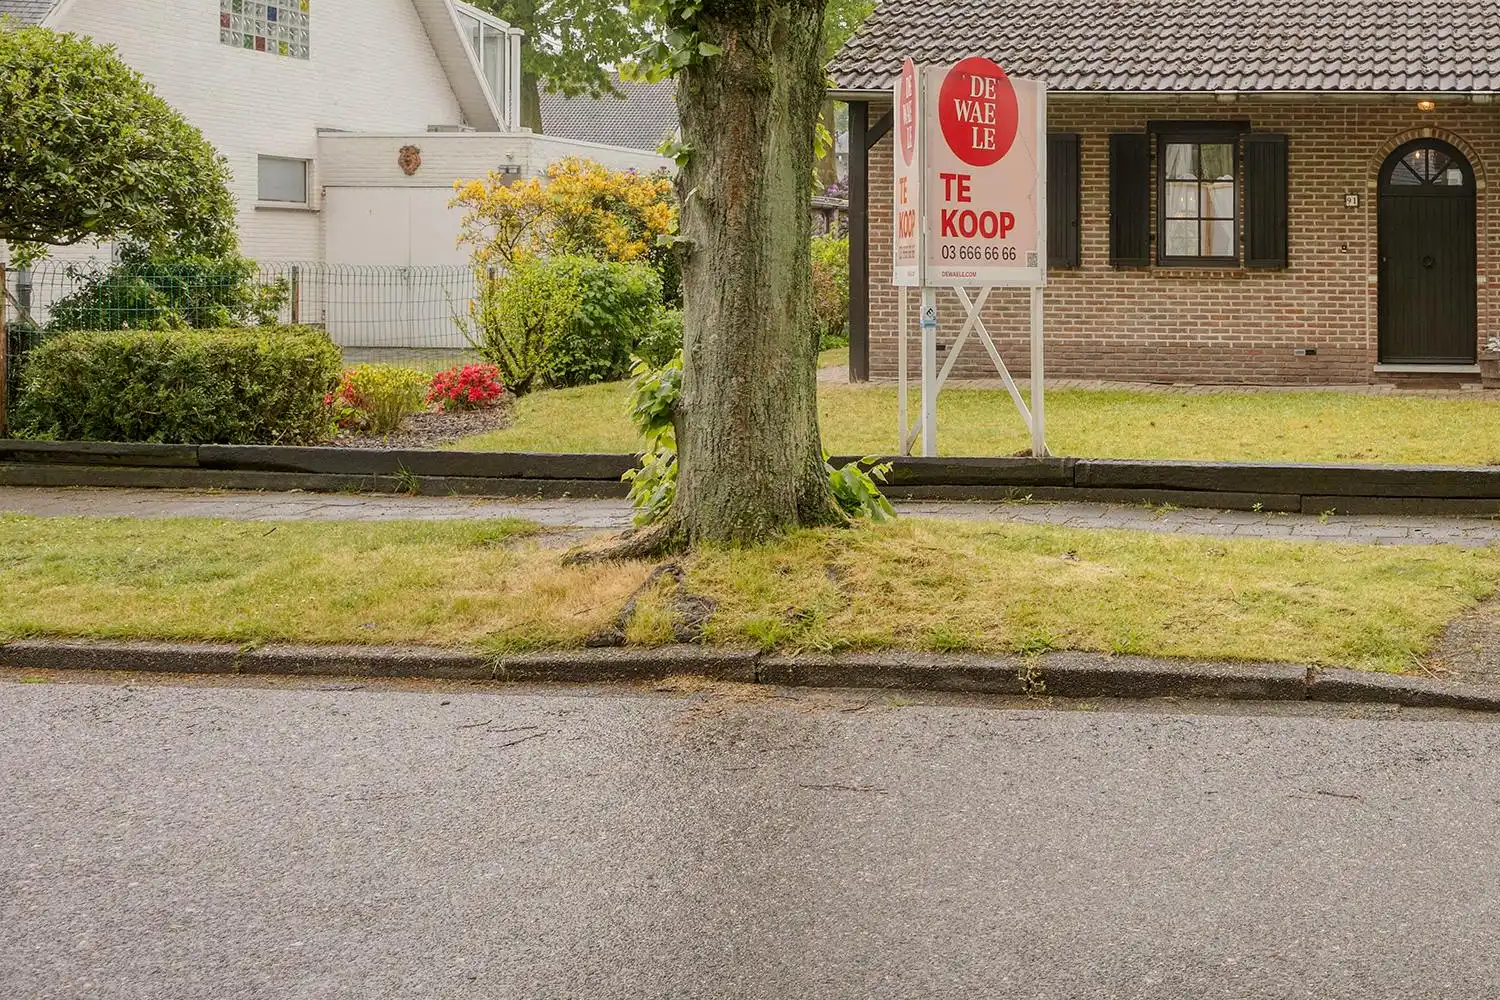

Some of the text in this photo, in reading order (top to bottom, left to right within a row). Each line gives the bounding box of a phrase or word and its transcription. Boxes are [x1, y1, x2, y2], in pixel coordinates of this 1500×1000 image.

[970, 75, 996, 99] DE
[954, 99, 996, 125] WAE
[972, 127, 996, 150] LE
[940, 173, 971, 203] TE
[941, 209, 1015, 239] KOOP
[941, 245, 1017, 260] 03 666 66 66
